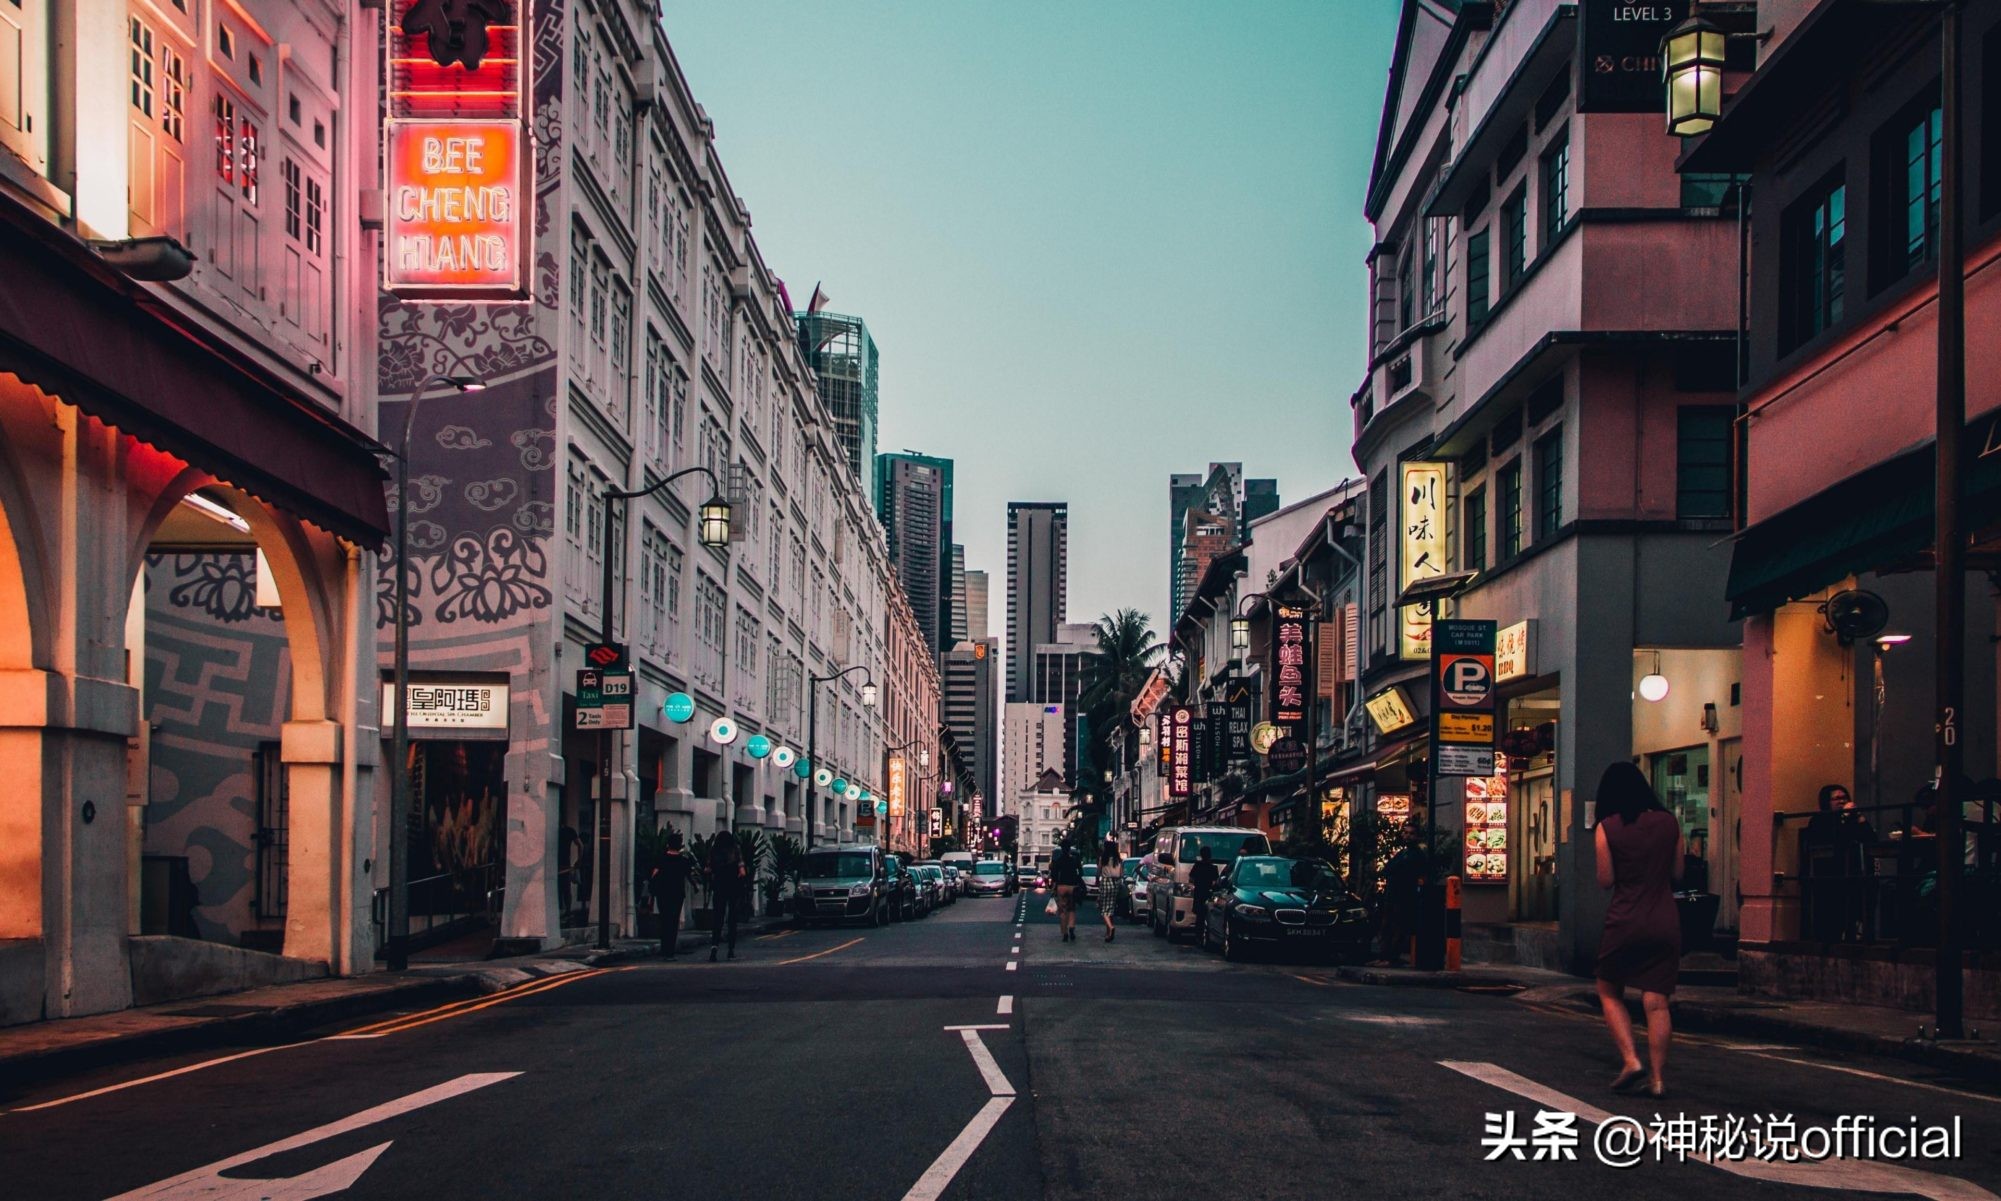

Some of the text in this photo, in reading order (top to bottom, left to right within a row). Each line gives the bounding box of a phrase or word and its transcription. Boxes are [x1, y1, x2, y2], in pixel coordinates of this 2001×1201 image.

[1614, 7, 1672, 21] LEVEL 3
[1621, 56, 1666, 72] CHI
[423, 137, 484, 174] BEE
[398, 186, 511, 223] CHENG
[399, 235, 508, 272] HIANG
[1450, 631, 1484, 639] CAR PARK
[1498, 659, 1514, 676] BBQ
[1454, 662, 1486, 691] P
[582, 691, 599, 699] Taxi
[605, 683, 627, 693] D19
[578, 711, 588, 725] 2
[1231, 707, 1246, 719] THAI
[1228, 721, 1248, 734] RELAX
[1232, 736, 1245, 748] SPA
